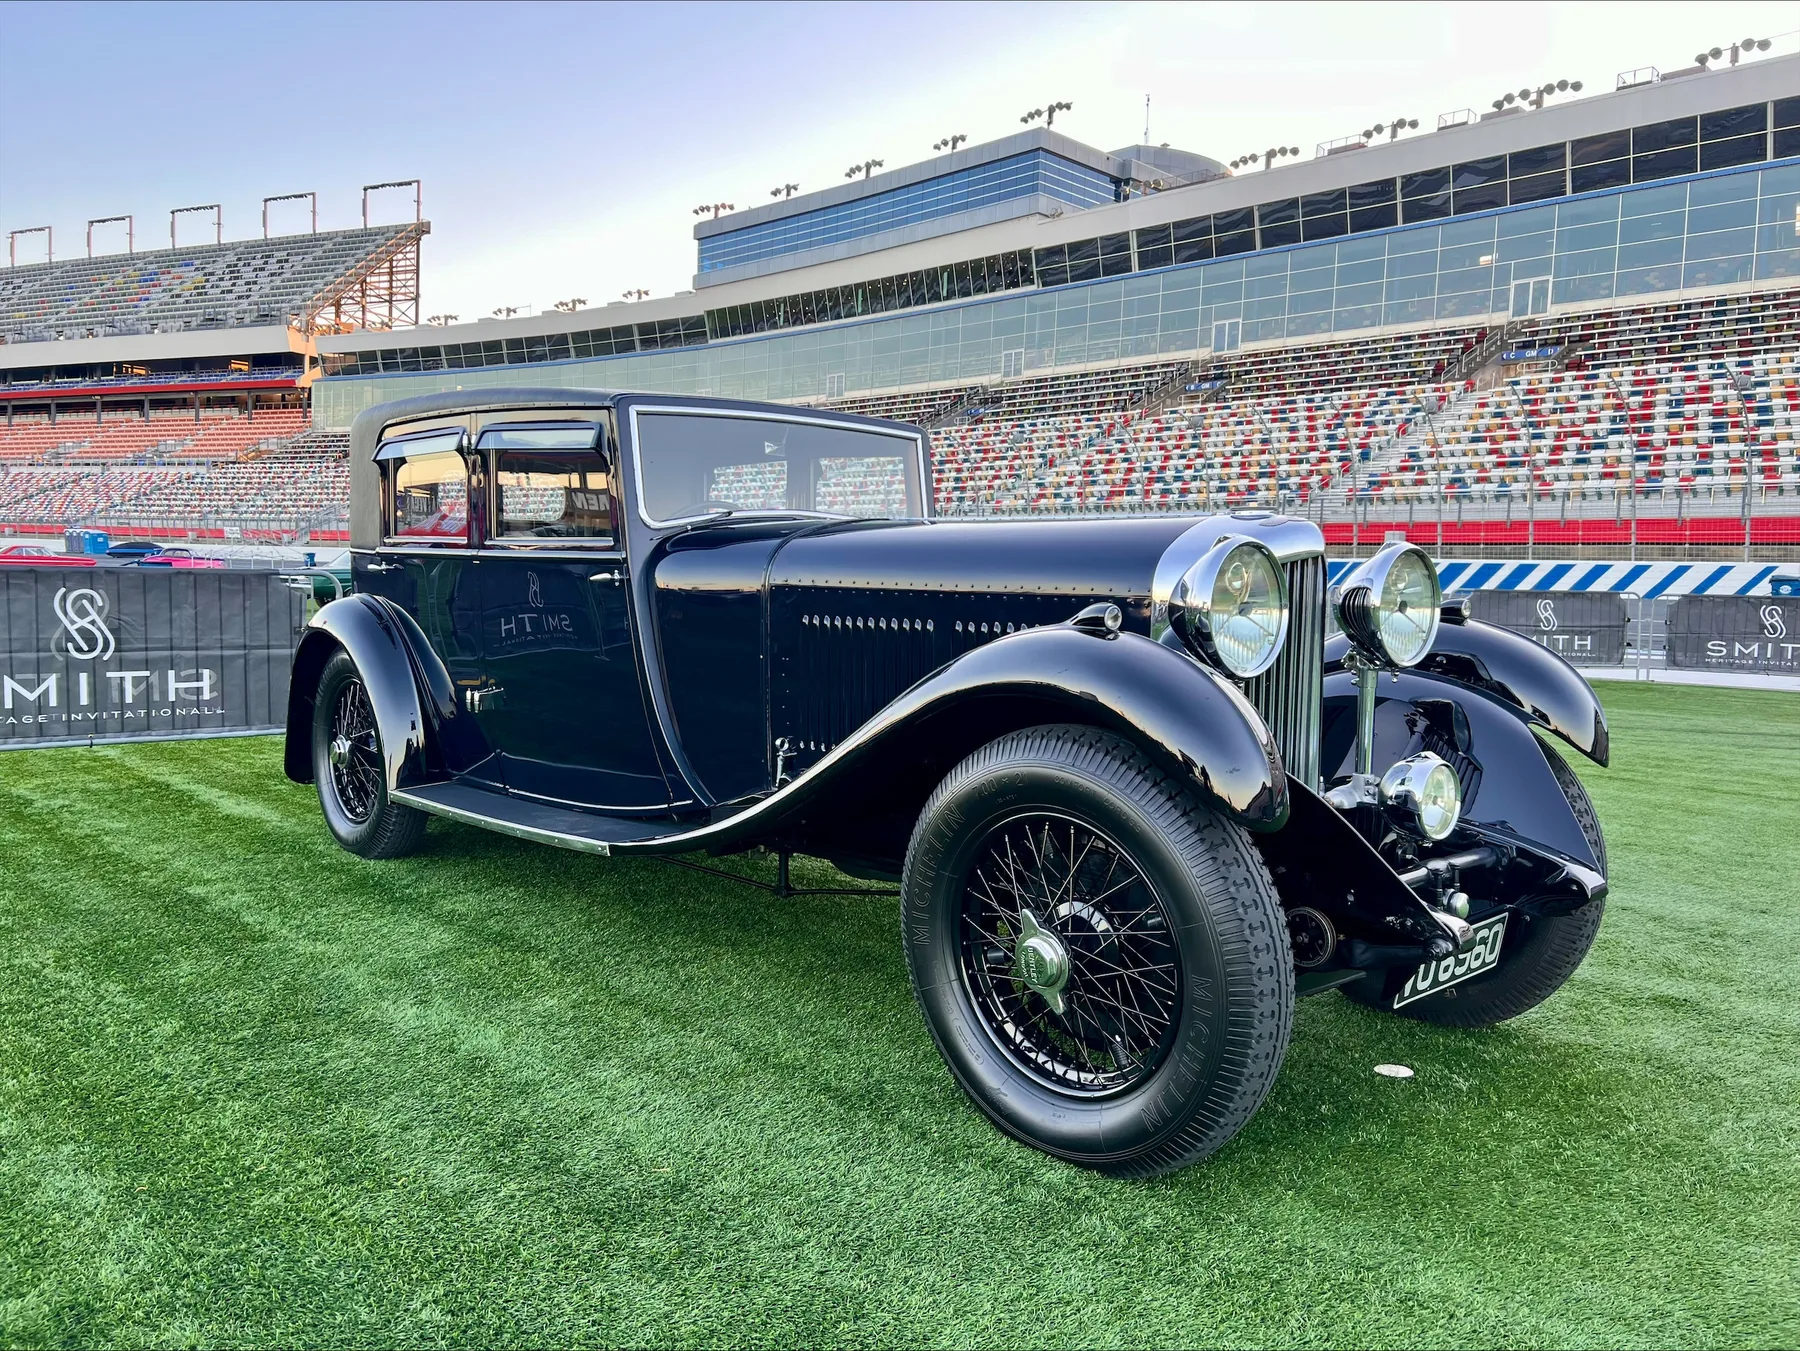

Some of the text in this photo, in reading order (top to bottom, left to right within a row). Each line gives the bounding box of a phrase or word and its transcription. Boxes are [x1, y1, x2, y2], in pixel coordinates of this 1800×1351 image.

[1525, 350, 1537, 358] GM
[1532, 635, 1591, 650] ITH
[4, 668, 210, 709] MITH
[0, 714, 49, 725] AGE
[62, 706, 213, 722] INVITATIONAL
[911, 803, 966, 946] MICHELIN
[1140, 974, 1213, 1132] MICHELIN
